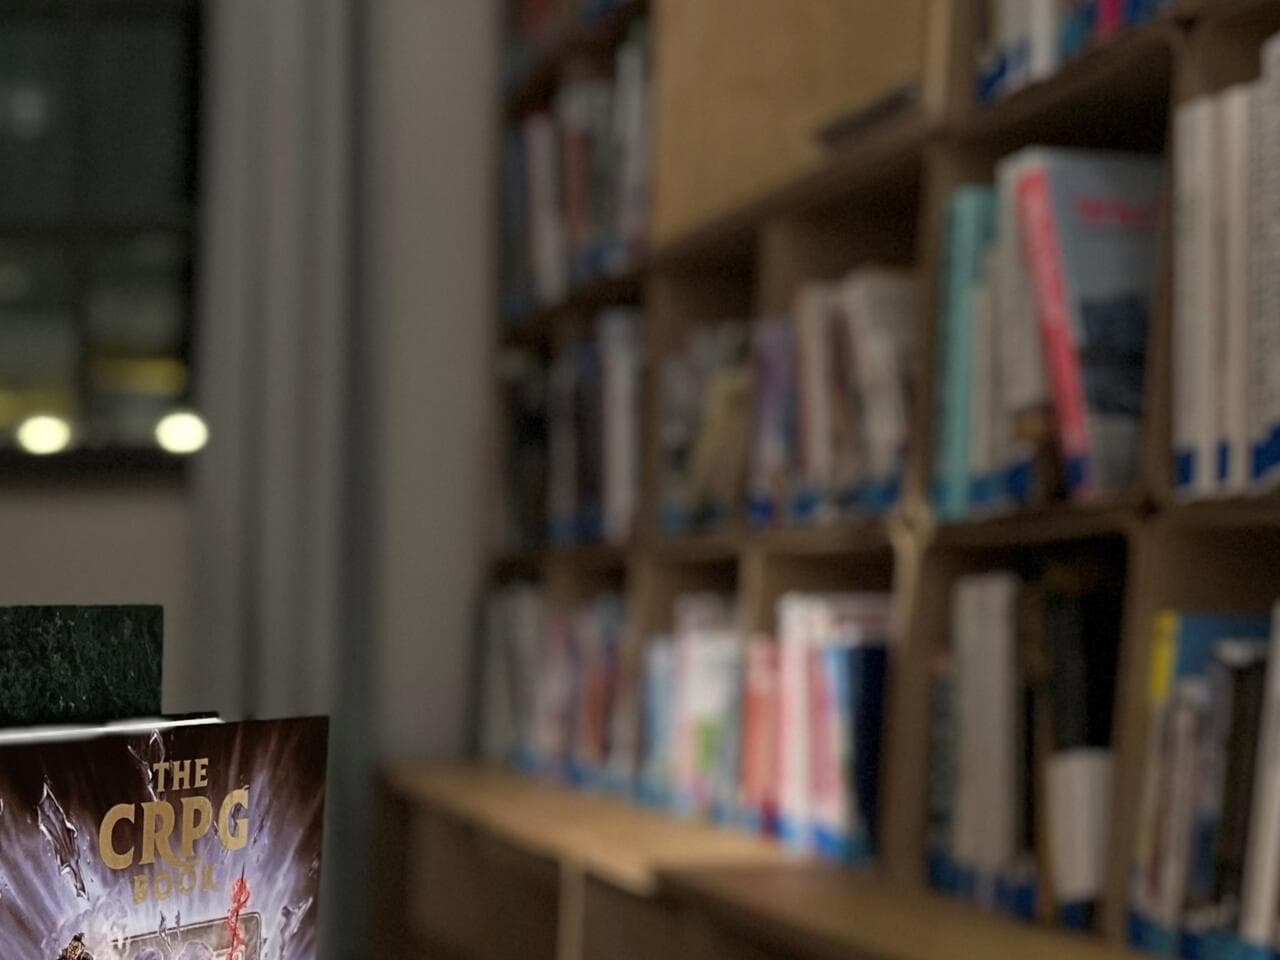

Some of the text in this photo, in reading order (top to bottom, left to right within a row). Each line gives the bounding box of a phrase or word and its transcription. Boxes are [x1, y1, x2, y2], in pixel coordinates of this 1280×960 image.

[152, 757, 209, 793] THE
[98, 785, 250, 870] CRPG
[132, 863, 220, 905] BOOK
